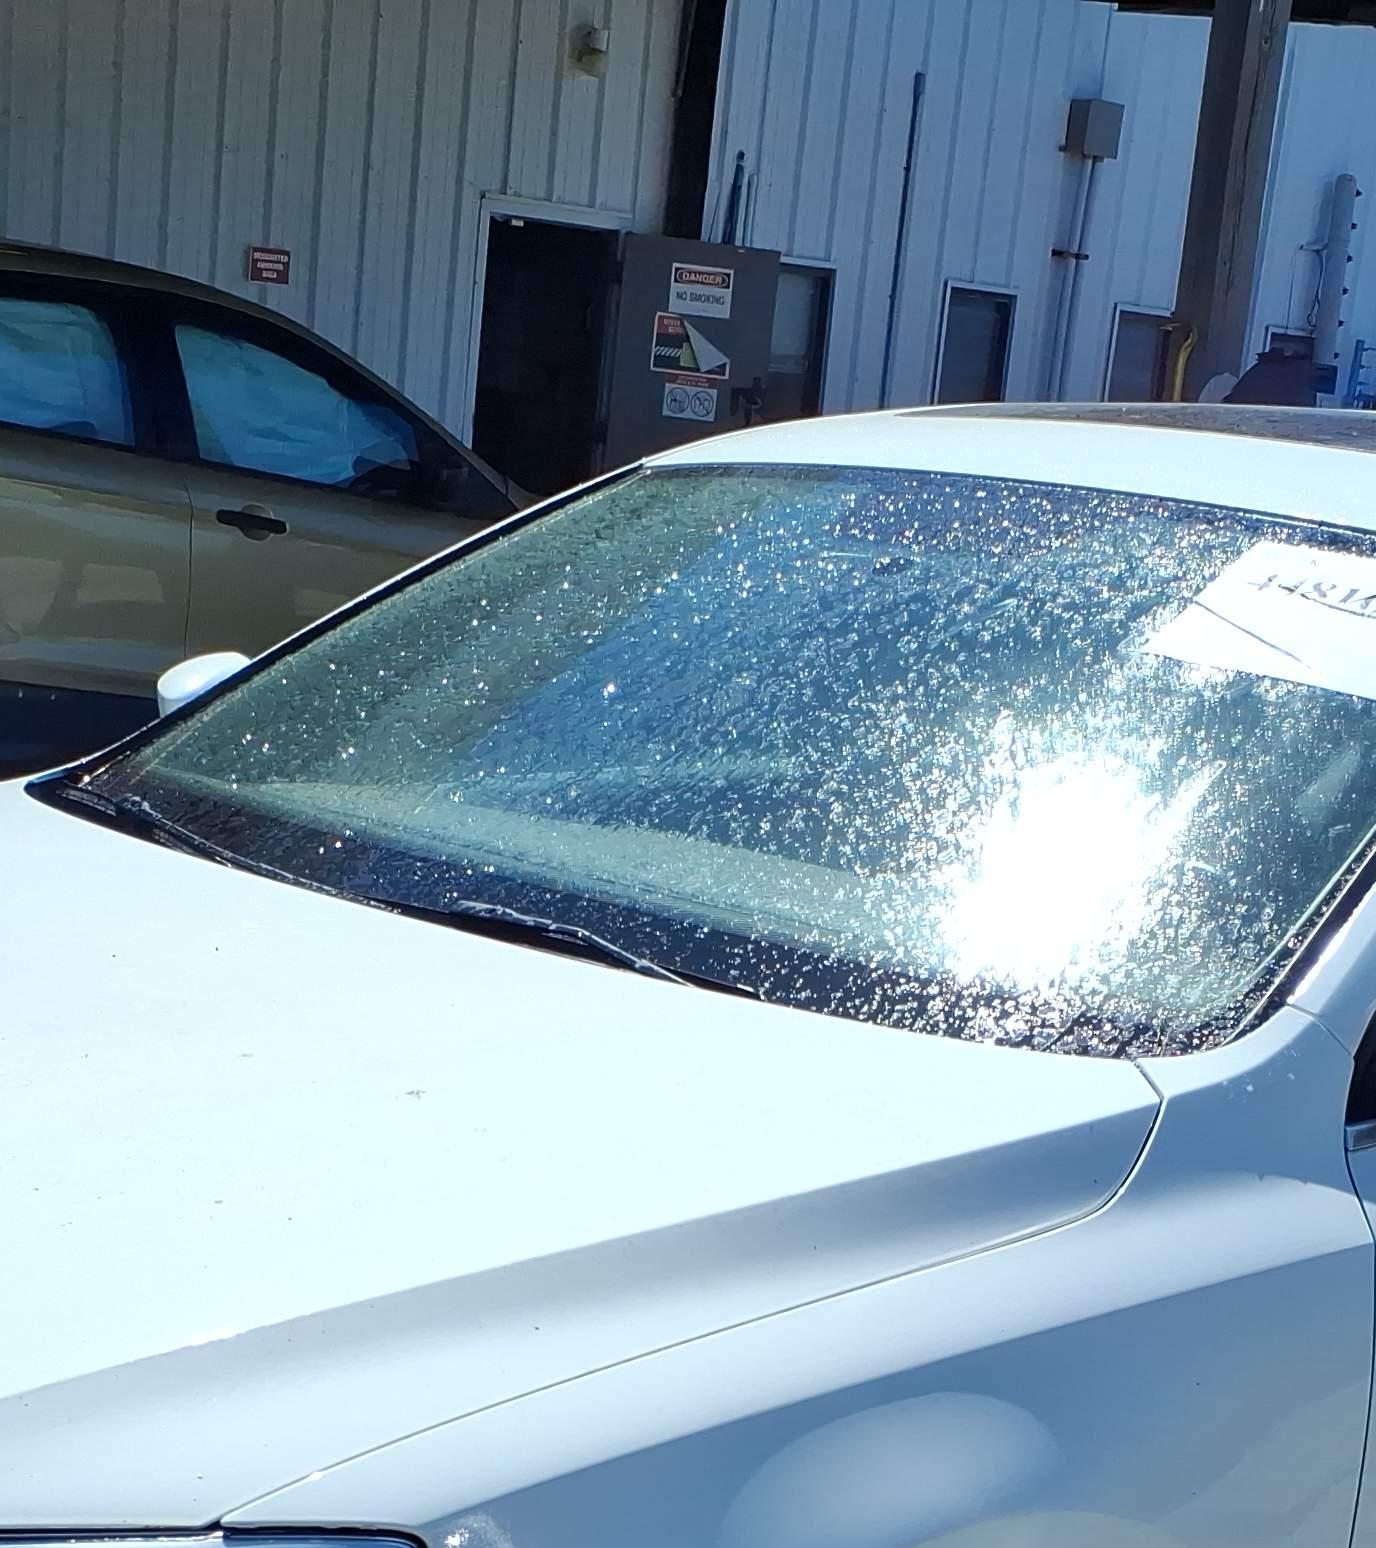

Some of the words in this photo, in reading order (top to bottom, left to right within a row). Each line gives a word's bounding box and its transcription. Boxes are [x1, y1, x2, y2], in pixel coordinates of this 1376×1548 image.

[682, 271, 722, 285] DANGER
[676, 291, 688, 302] NO
[688, 292, 725, 305] SMOKING
